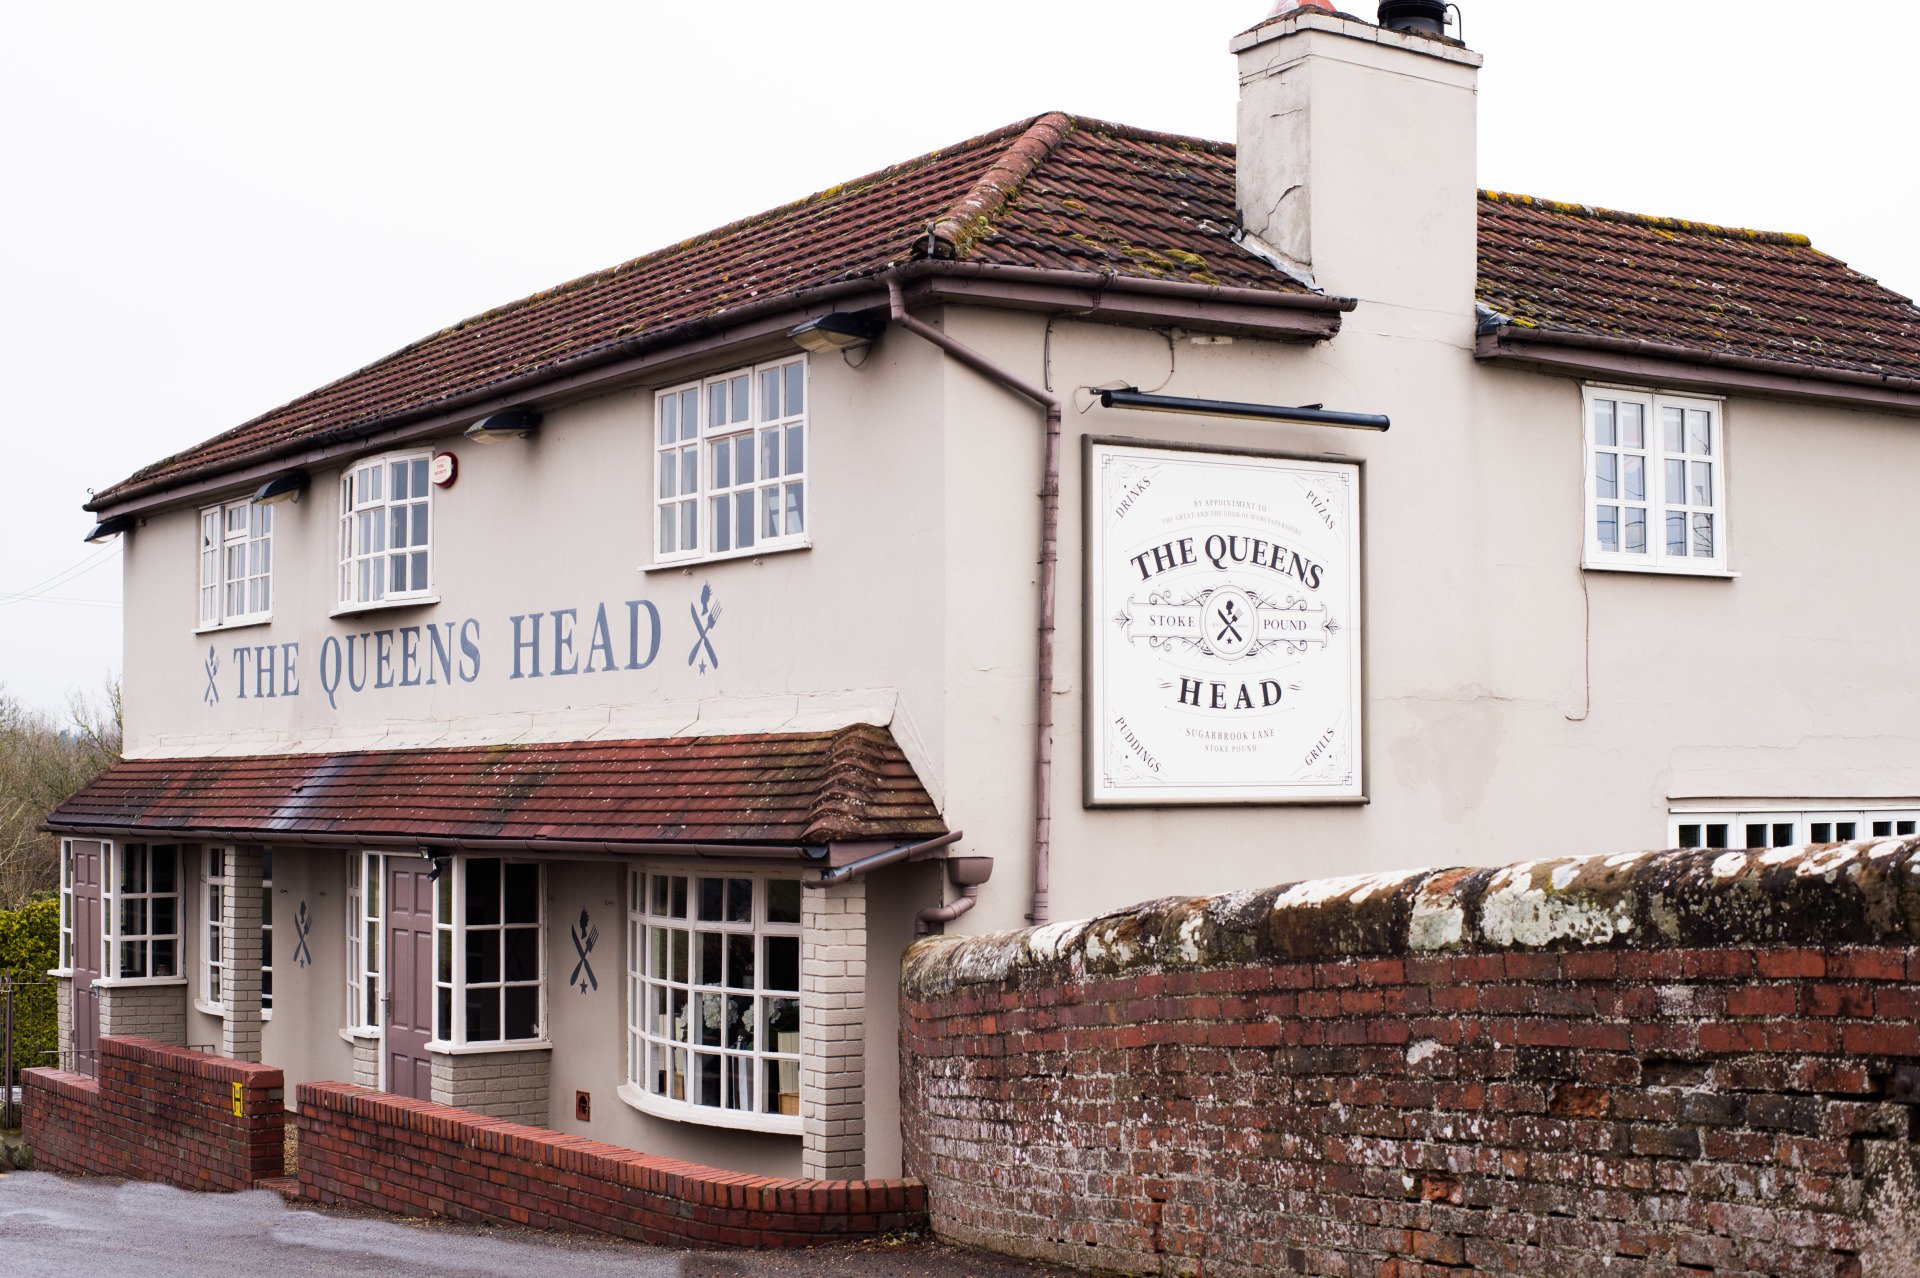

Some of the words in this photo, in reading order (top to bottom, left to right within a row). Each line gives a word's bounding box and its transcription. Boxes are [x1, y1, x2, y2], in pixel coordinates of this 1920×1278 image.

[1115, 475, 1151, 518] DRINKS
[1205, 499, 1255, 509] APPOINTMENT
[1258, 503, 1267, 512] TO
[1305, 490, 1335, 530] PIZZAS
[1175, 512, 1195, 521] GREAT
[1130, 537, 1198, 582] THE
[1204, 534, 1324, 590] QUEENS
[1149, 614, 1196, 628] STOKE
[1263, 619, 1307, 631] POUND
[233, 642, 300, 699] THE
[319, 617, 481, 710] QUEENS
[509, 599, 662, 680] HEAD
[1177, 676, 1282, 709] HEAD
[1115, 717, 1162, 773] PUDDINGS
[1186, 727, 1249, 741] SUGARBROOK
[1252, 728, 1275, 740] LANE
[1205, 744, 1228, 753] STOKE
[1232, 744, 1257, 753] POUND
[1304, 728, 1335, 766] GRILLS
